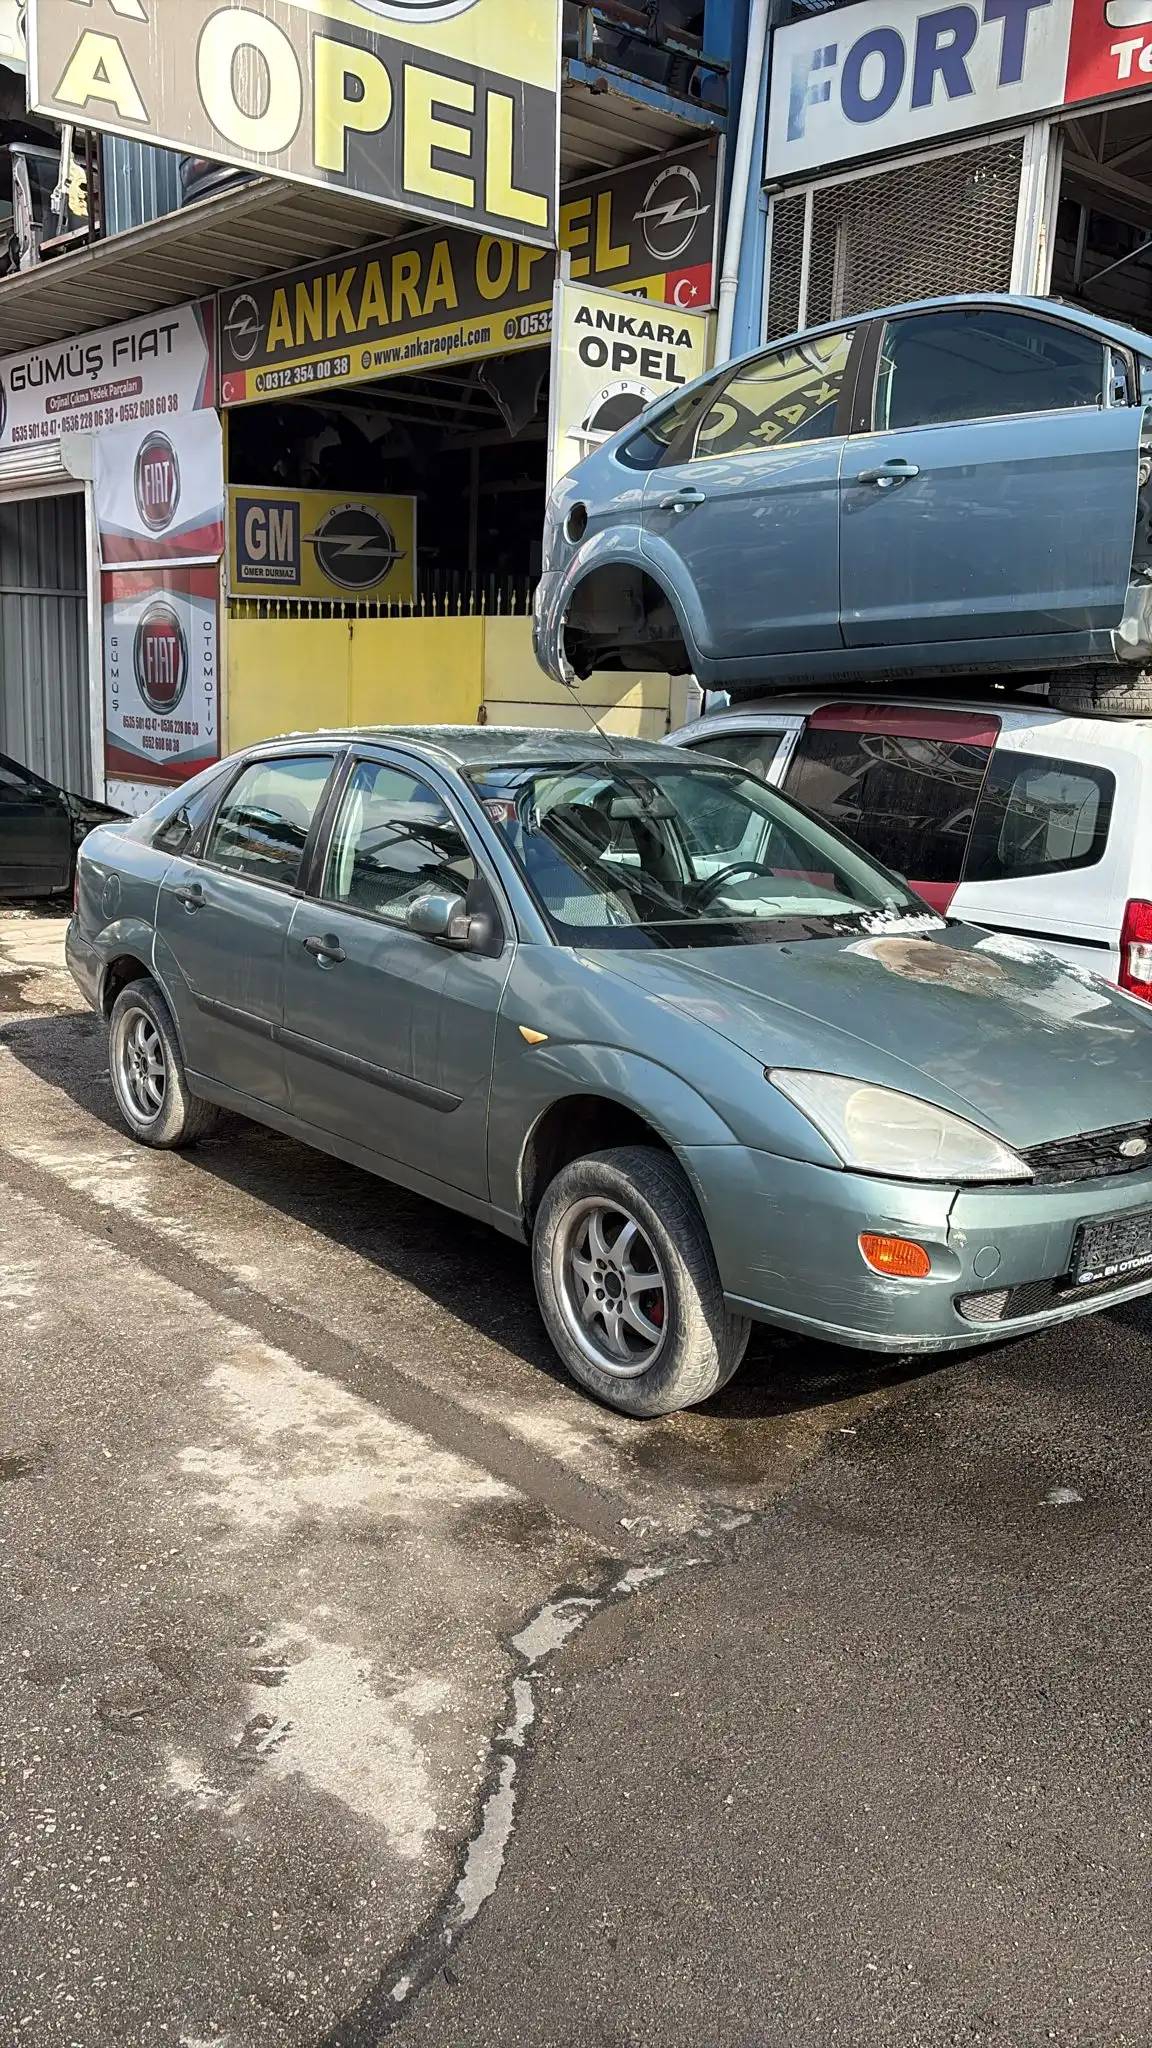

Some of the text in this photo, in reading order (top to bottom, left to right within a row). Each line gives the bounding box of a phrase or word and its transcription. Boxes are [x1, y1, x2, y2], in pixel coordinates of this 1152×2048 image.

[786, 0, 1053, 142] FORT
[195, 6, 549, 230] OPEL
[266, 240, 459, 353] ANKARA
[373, 327, 491, 366] www.ankaraopel.com
[574, 306, 693, 349] ANKARA
[10, 322, 180, 391] GÜMÜŞ FIAT
[265, 357, 348, 389] 0312 354 00 38
[578, 335, 686, 385] OPEL
[89, 386, 109, 401] Yedek
[601, 382, 647, 399] OPE
[12, 393, 179, 442] 0535 501 43 47 0536 228 06 38 0552 608 60 38
[144, 461, 170, 505] FIAT
[244, 506, 294, 562] GM
[329, 503, 381, 519] OPEL
[243, 565, 295, 578] ÖMER DURMAZ
[111, 637, 119, 711] GÜMÜŞ
[146, 636, 175, 684] FIAT
